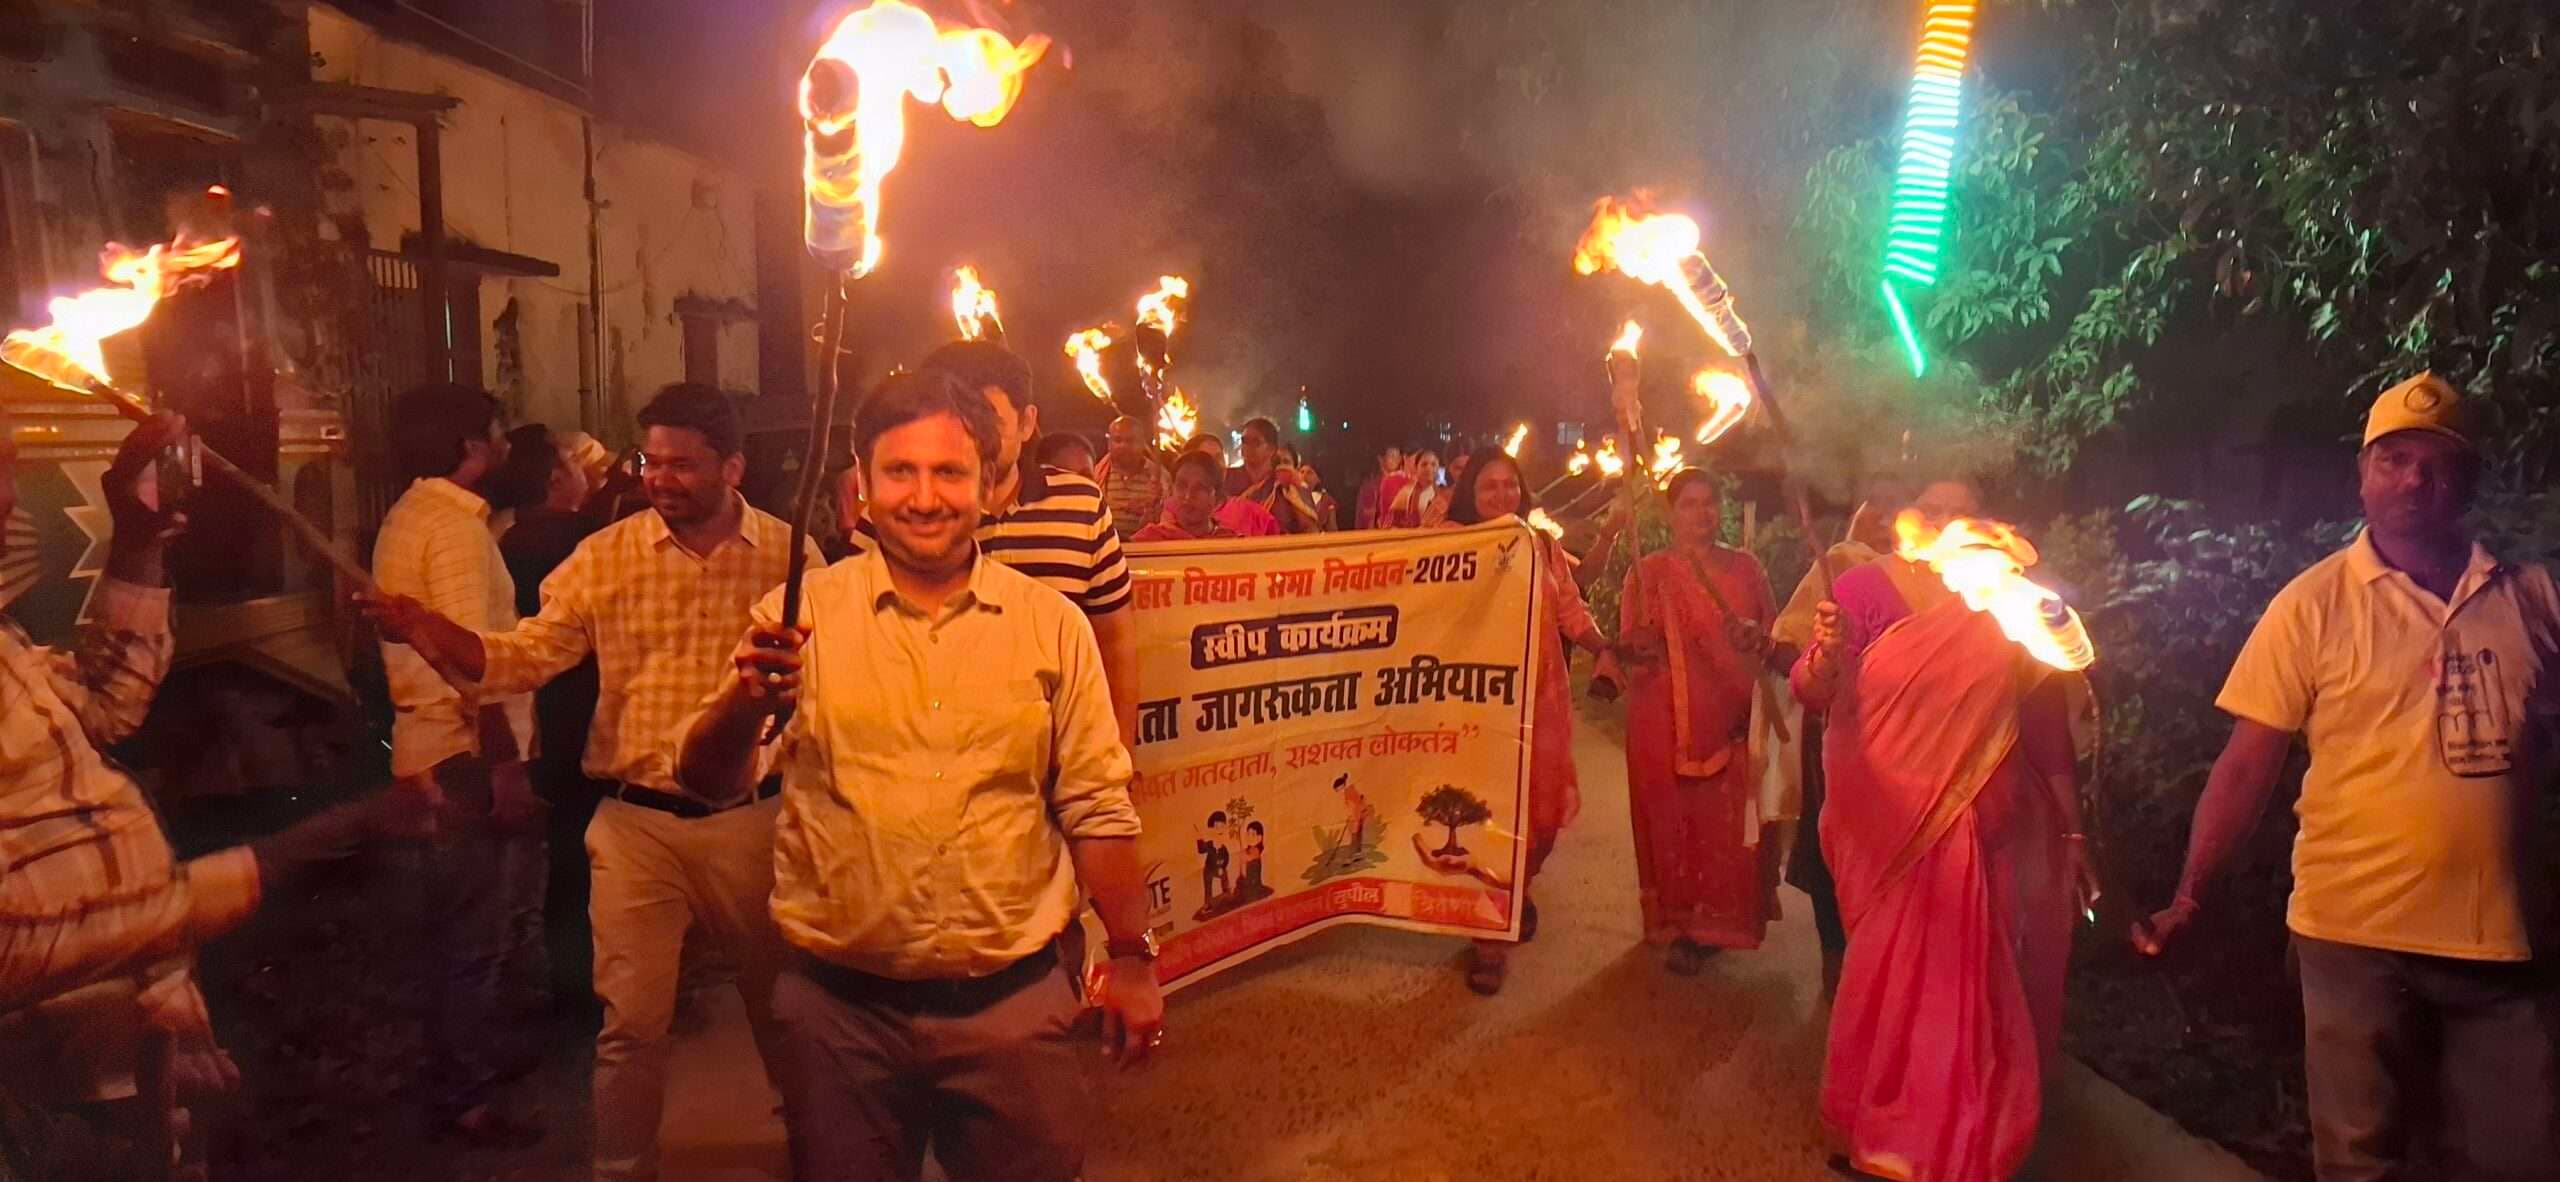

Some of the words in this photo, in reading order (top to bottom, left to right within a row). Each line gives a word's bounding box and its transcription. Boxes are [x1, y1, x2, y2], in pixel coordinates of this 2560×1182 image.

[1129, 577, 1175, 612] हार
[1202, 623, 1269, 663] स्वीप
[1277, 611, 1392, 652] कार्यक्रम
[1374, 655, 1519, 706] अभियान
[1286, 737, 1363, 769] सशक्त
